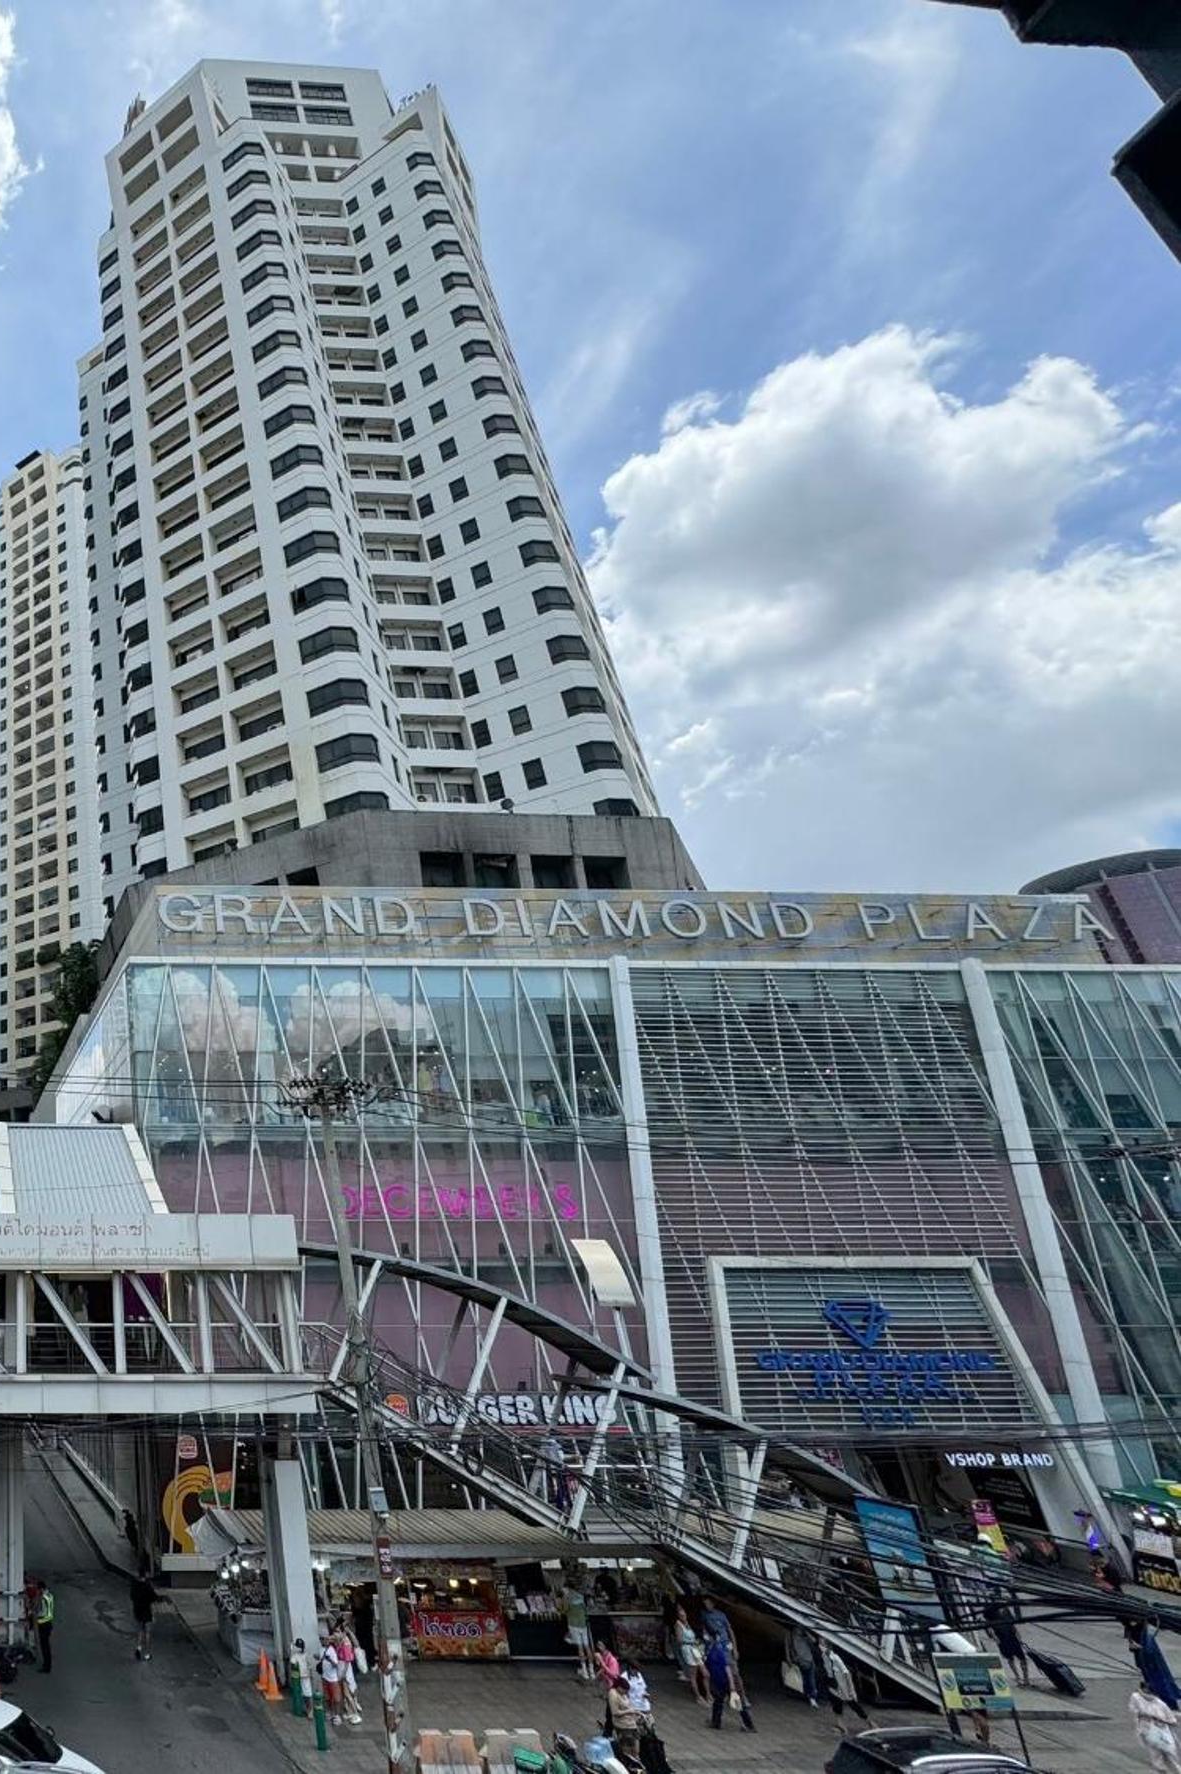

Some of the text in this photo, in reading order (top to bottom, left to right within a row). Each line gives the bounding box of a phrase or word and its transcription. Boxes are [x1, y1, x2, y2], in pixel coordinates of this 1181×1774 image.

[157, 893, 1116, 942] GRAND DIAMOND PLAZA
[944, 1453, 1054, 1467] VSHOP BRAND
